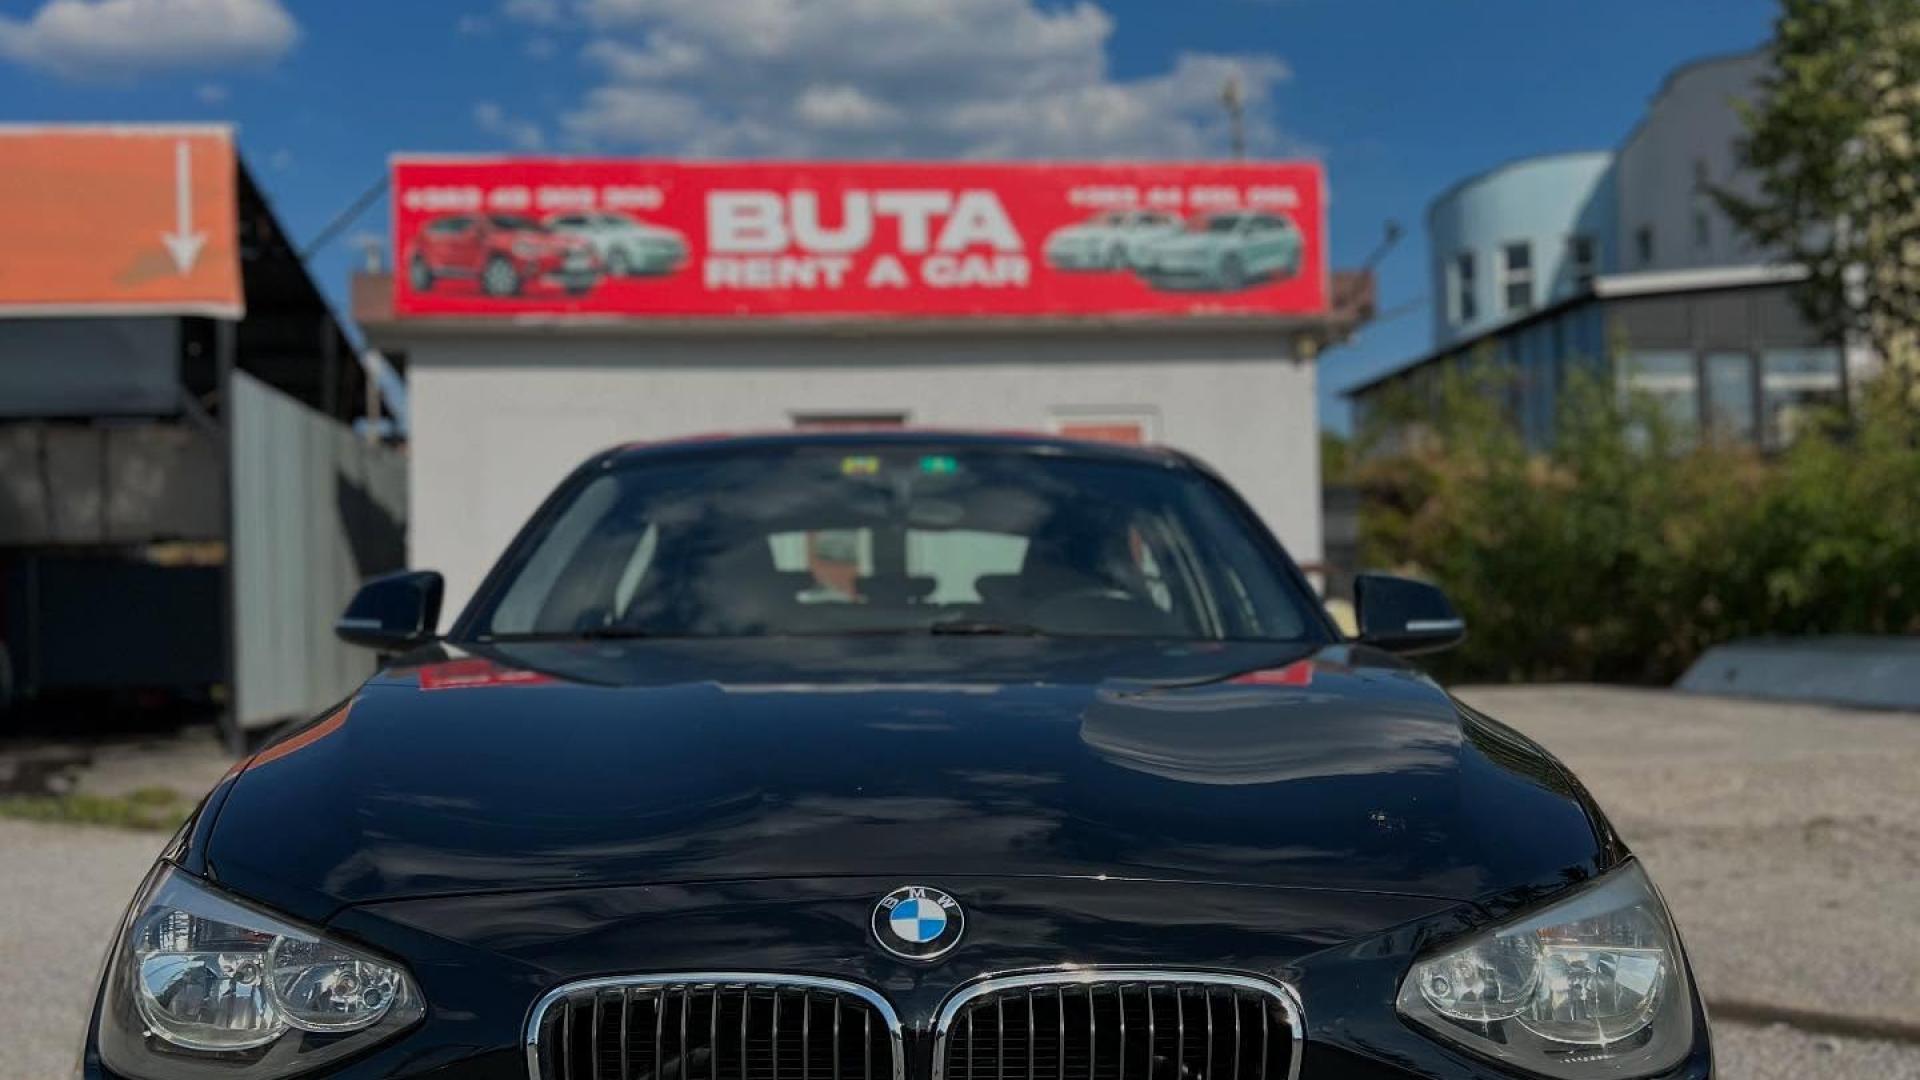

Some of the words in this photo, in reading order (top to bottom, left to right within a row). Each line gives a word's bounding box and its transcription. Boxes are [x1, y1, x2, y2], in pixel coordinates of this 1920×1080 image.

[706, 189, 1022, 254] BUTA
[704, 256, 850, 289] RENT
[866, 256, 910, 288] A
[921, 255, 1029, 287] CAR
[881, 888, 955, 909] BMW
